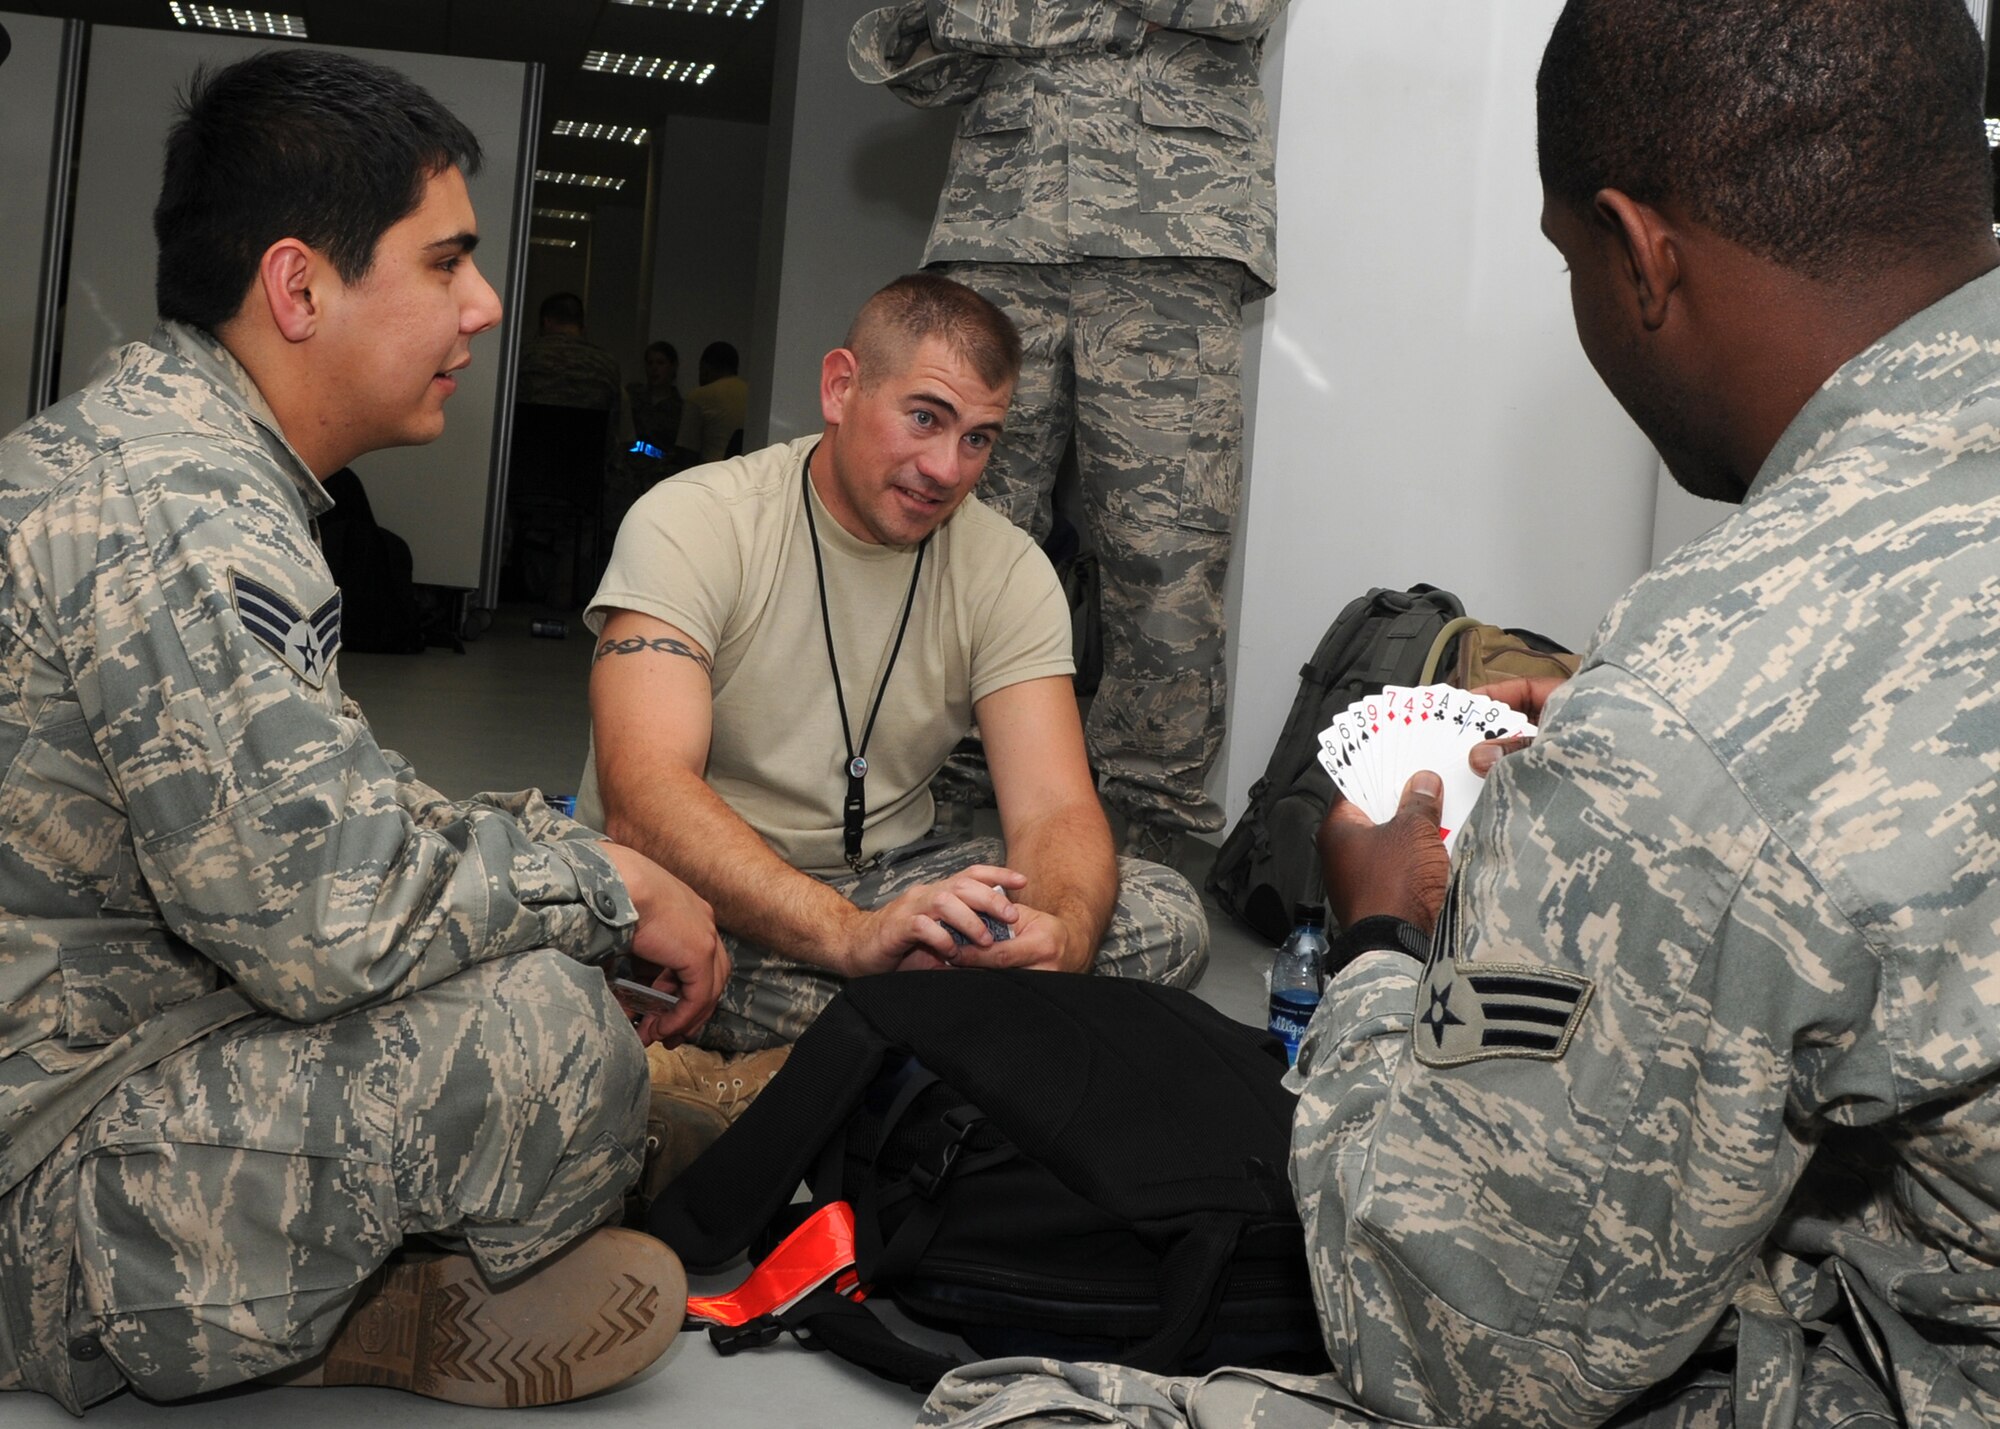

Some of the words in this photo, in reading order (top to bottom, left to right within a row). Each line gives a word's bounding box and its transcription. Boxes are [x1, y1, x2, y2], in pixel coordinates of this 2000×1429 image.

[1387, 691, 1397, 708] 7
[1404, 697, 1414, 712] 4
[1422, 691, 1435, 709] 3
[1438, 693, 1449, 709] A
[1459, 699, 1475, 714] J
[1354, 711, 1366, 728] 3
[1366, 704, 1378, 721] 9
[1485, 707, 1499, 722] 8
[1338, 723, 1350, 739] 6
[1324, 739, 1337, 756] 8
